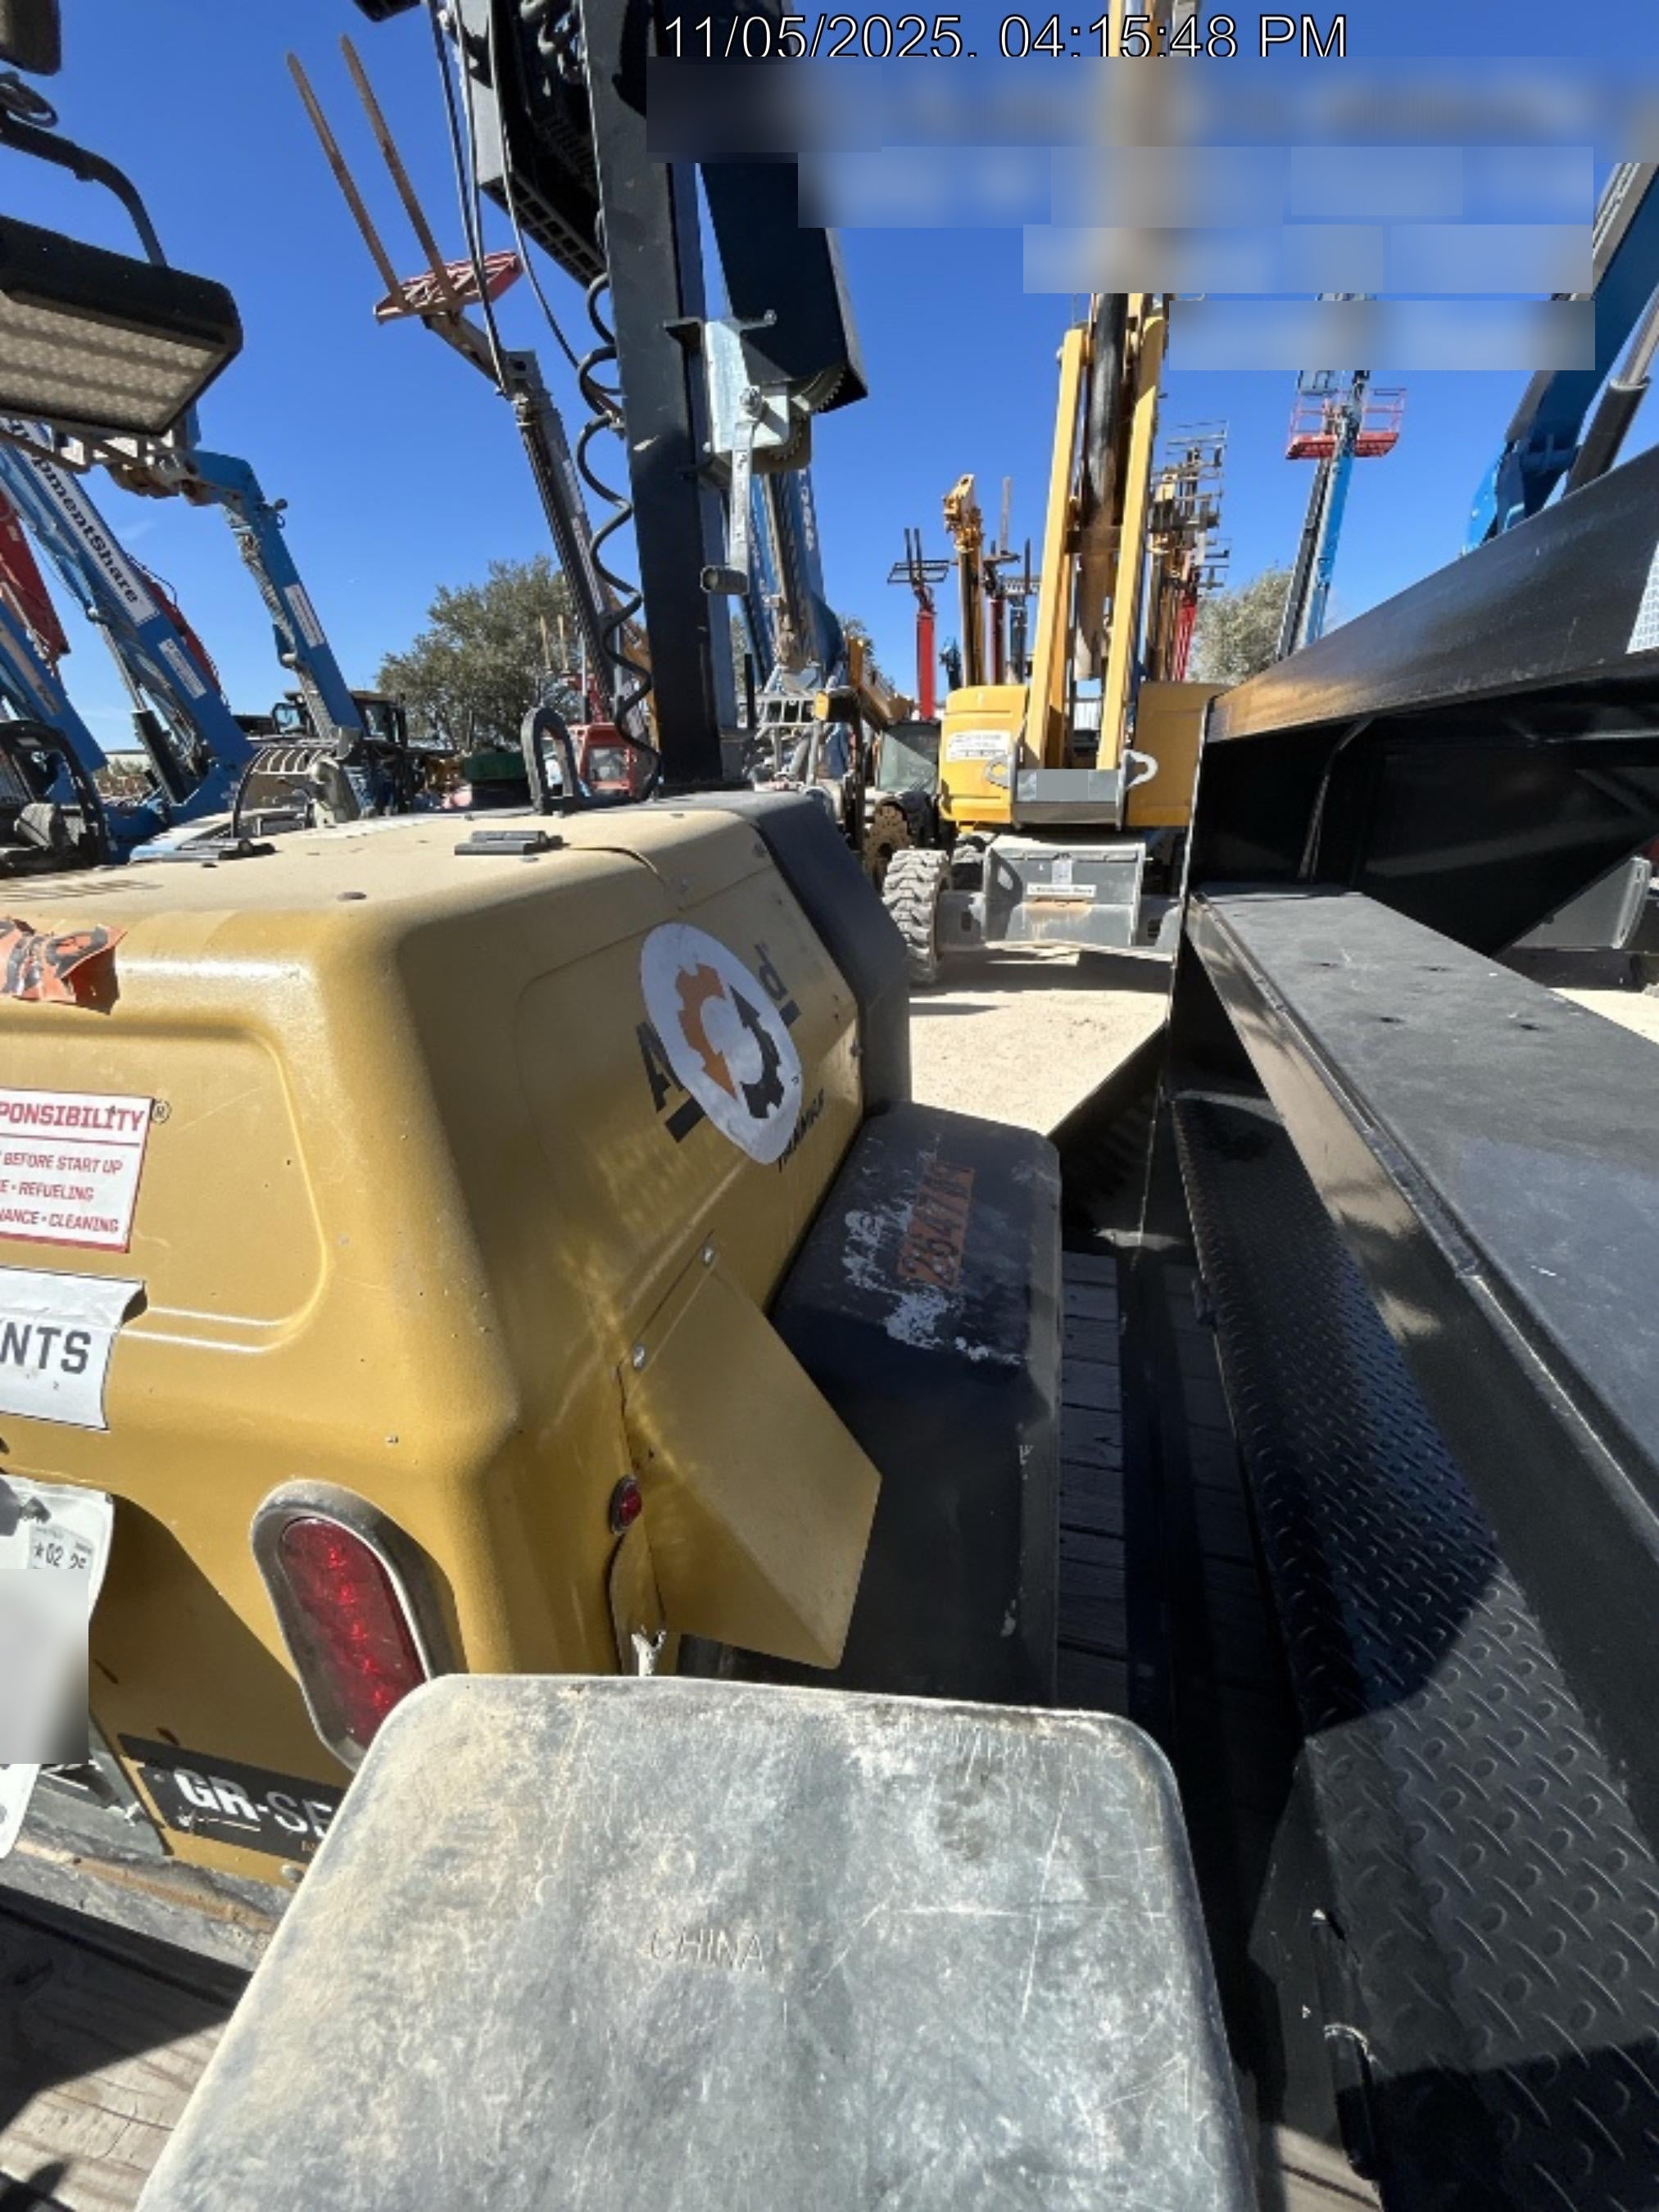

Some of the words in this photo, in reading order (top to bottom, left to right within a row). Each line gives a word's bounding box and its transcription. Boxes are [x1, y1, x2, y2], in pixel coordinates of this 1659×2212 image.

[3, 1152, 54, 1169] BEFORE
[56, 1155, 101, 1172] START
[102, 1159, 124, 1175] UP
[19, 1181, 94, 1202] REFUELING
[48, 1213, 119, 1232] CLEANING
[0, 1321, 91, 1375] NTS
[650, 1926, 765, 1972] CHINA
